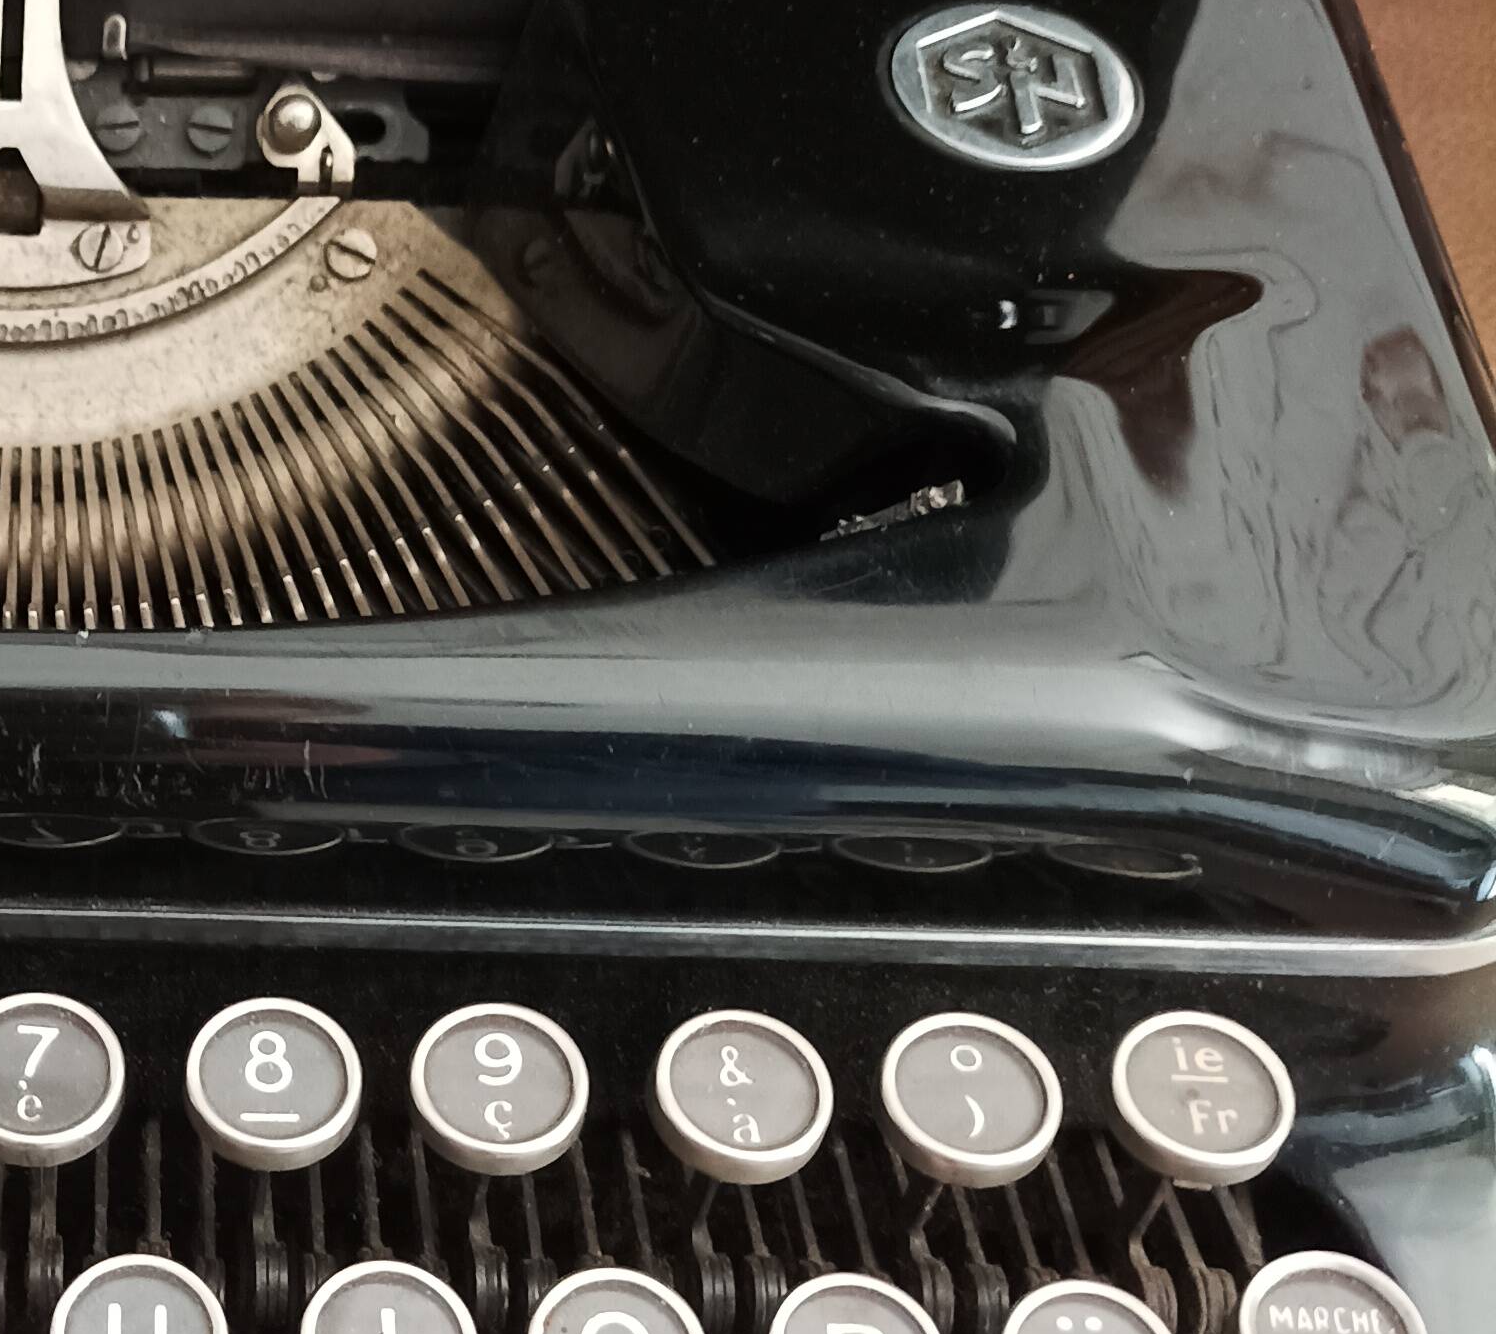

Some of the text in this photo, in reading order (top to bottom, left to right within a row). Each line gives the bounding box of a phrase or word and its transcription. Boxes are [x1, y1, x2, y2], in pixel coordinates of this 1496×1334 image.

[16, 1024, 60, 1078] 7
[244, 1030, 293, 1094] 8
[474, 1032, 523, 1087] 9
[719, 1045, 754, 1087] &
[483, 1100, 513, 1140] ç
[1188, 1099, 1238, 1135] Fr
